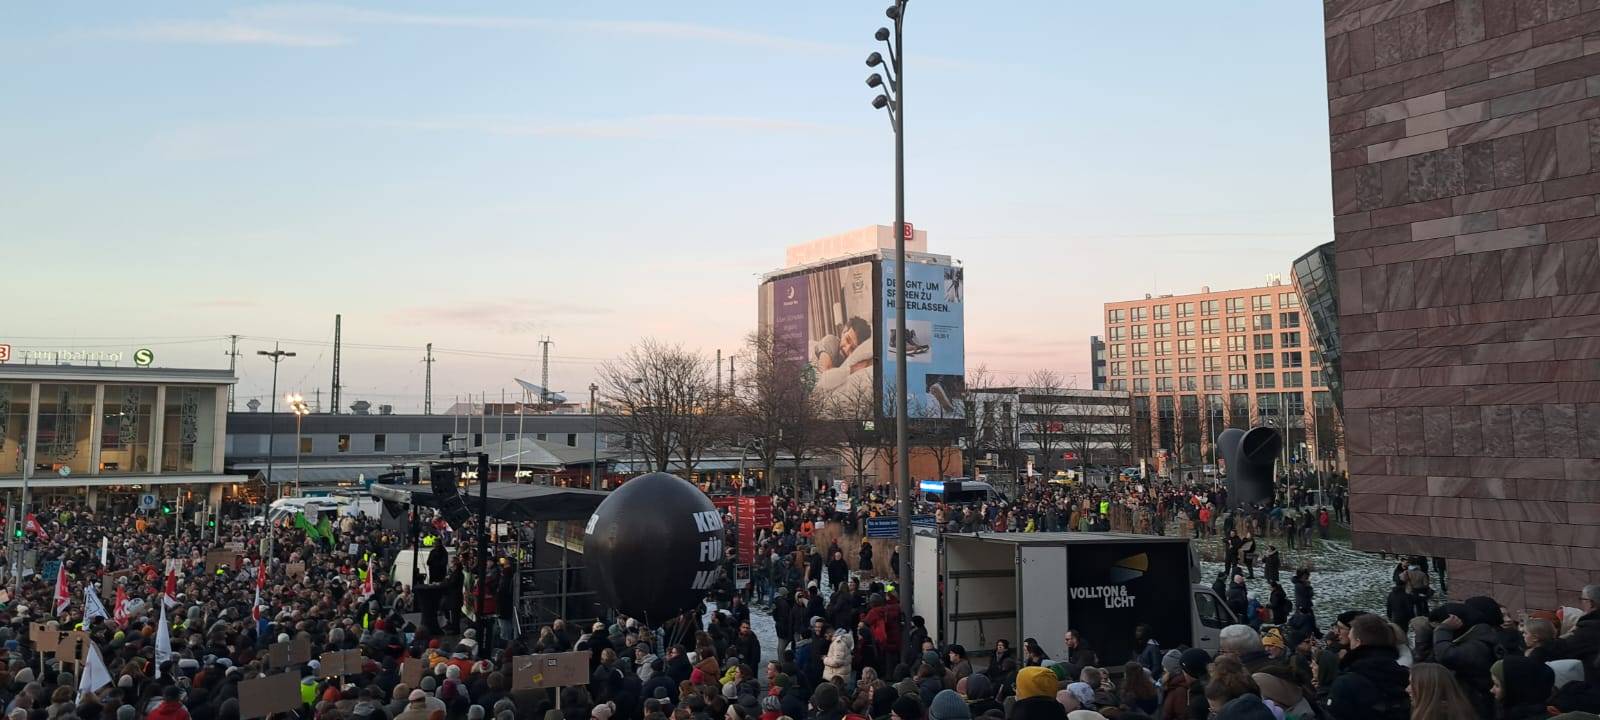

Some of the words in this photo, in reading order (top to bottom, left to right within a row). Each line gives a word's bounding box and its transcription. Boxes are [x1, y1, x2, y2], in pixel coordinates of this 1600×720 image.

[886, 278, 925, 292] DEGNT,
[926, 282, 939, 291] UM
[886, 289, 919, 300] SPREN
[920, 292, 932, 301] ZU
[136, 350, 151, 364] S
[1105, 595, 1136, 609] LICHT
